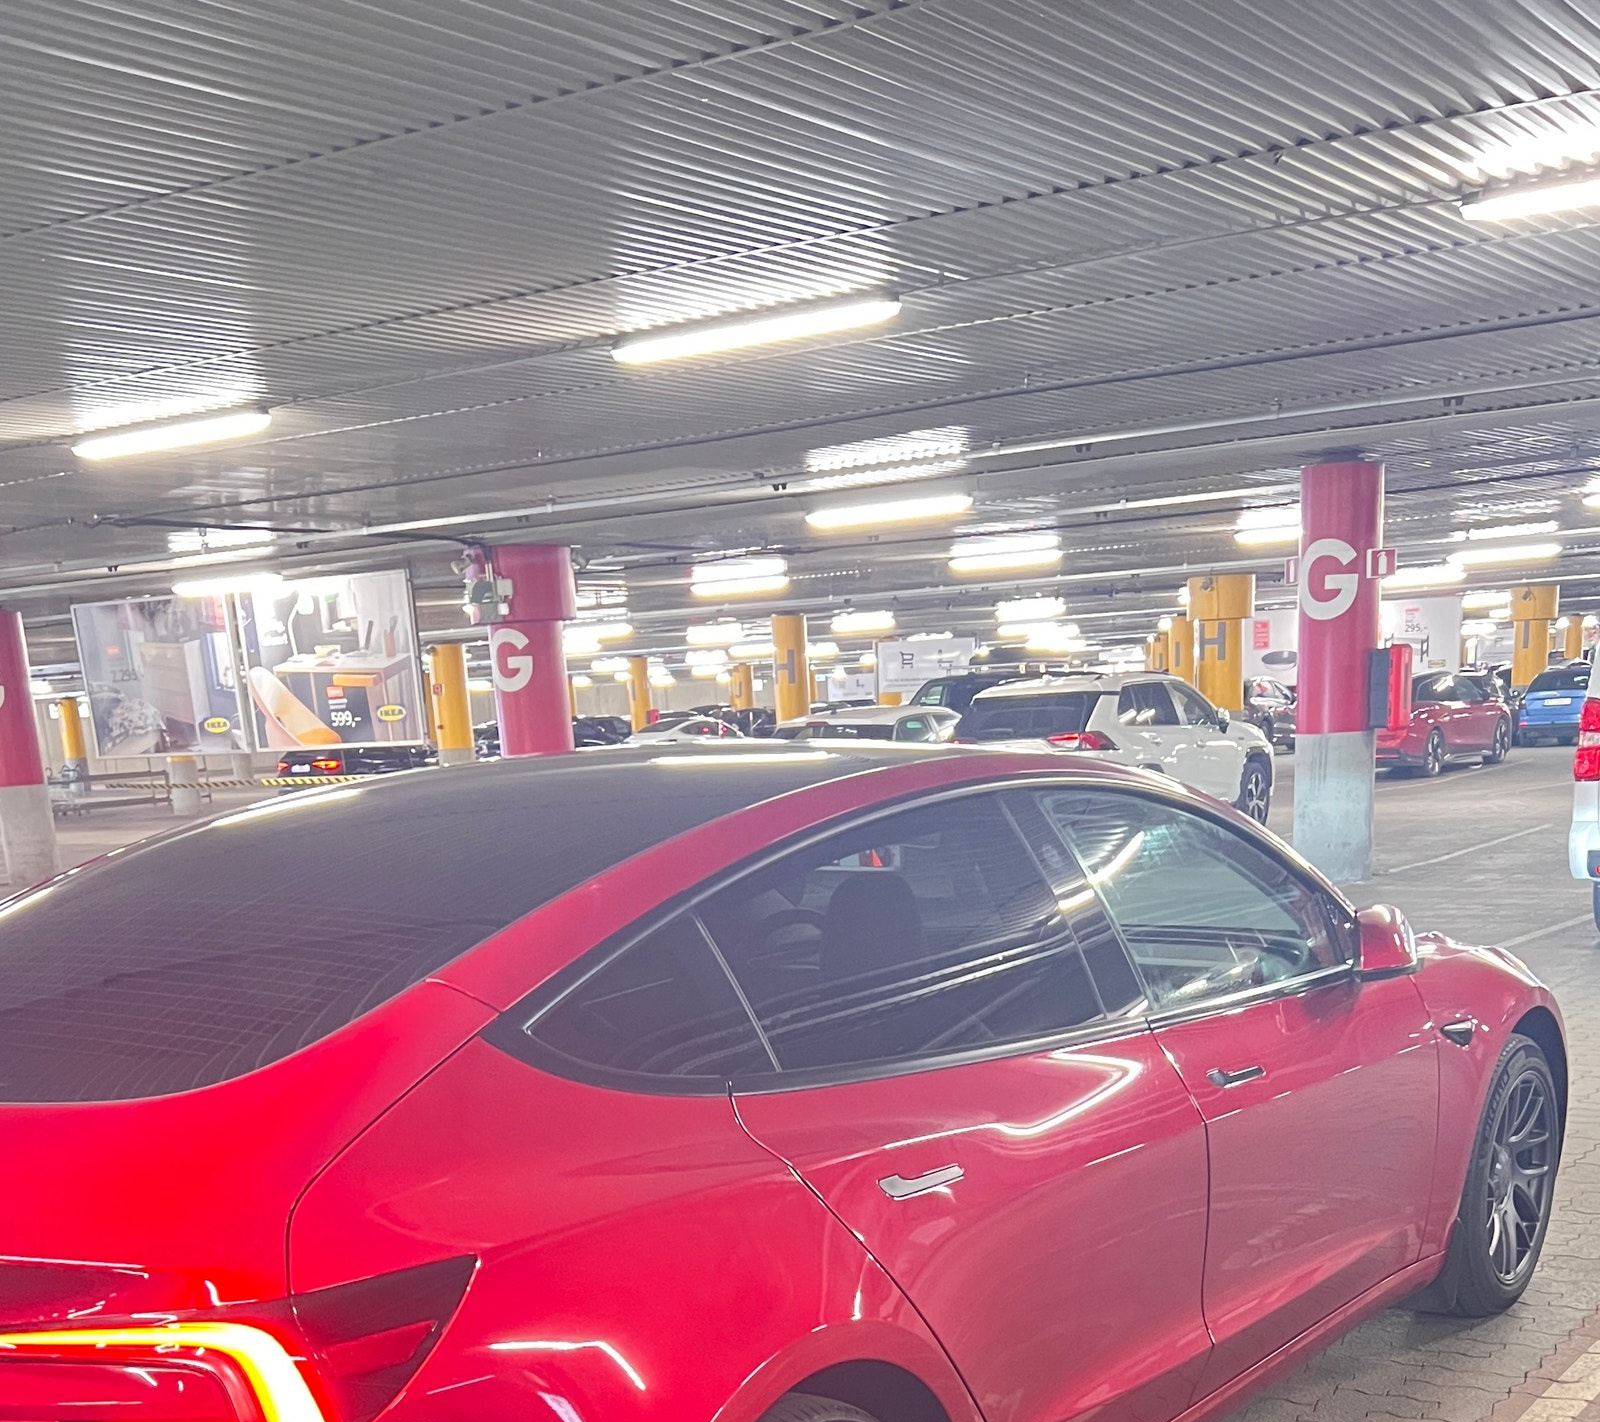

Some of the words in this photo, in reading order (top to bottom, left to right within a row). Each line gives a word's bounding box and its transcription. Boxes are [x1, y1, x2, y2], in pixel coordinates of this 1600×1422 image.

[1300, 537, 1359, 620] G
[490, 628, 534, 693] G
[1200, 621, 1226, 661] H
[774, 649, 796, 684] H
[330, 710, 362, 728] 599,-
